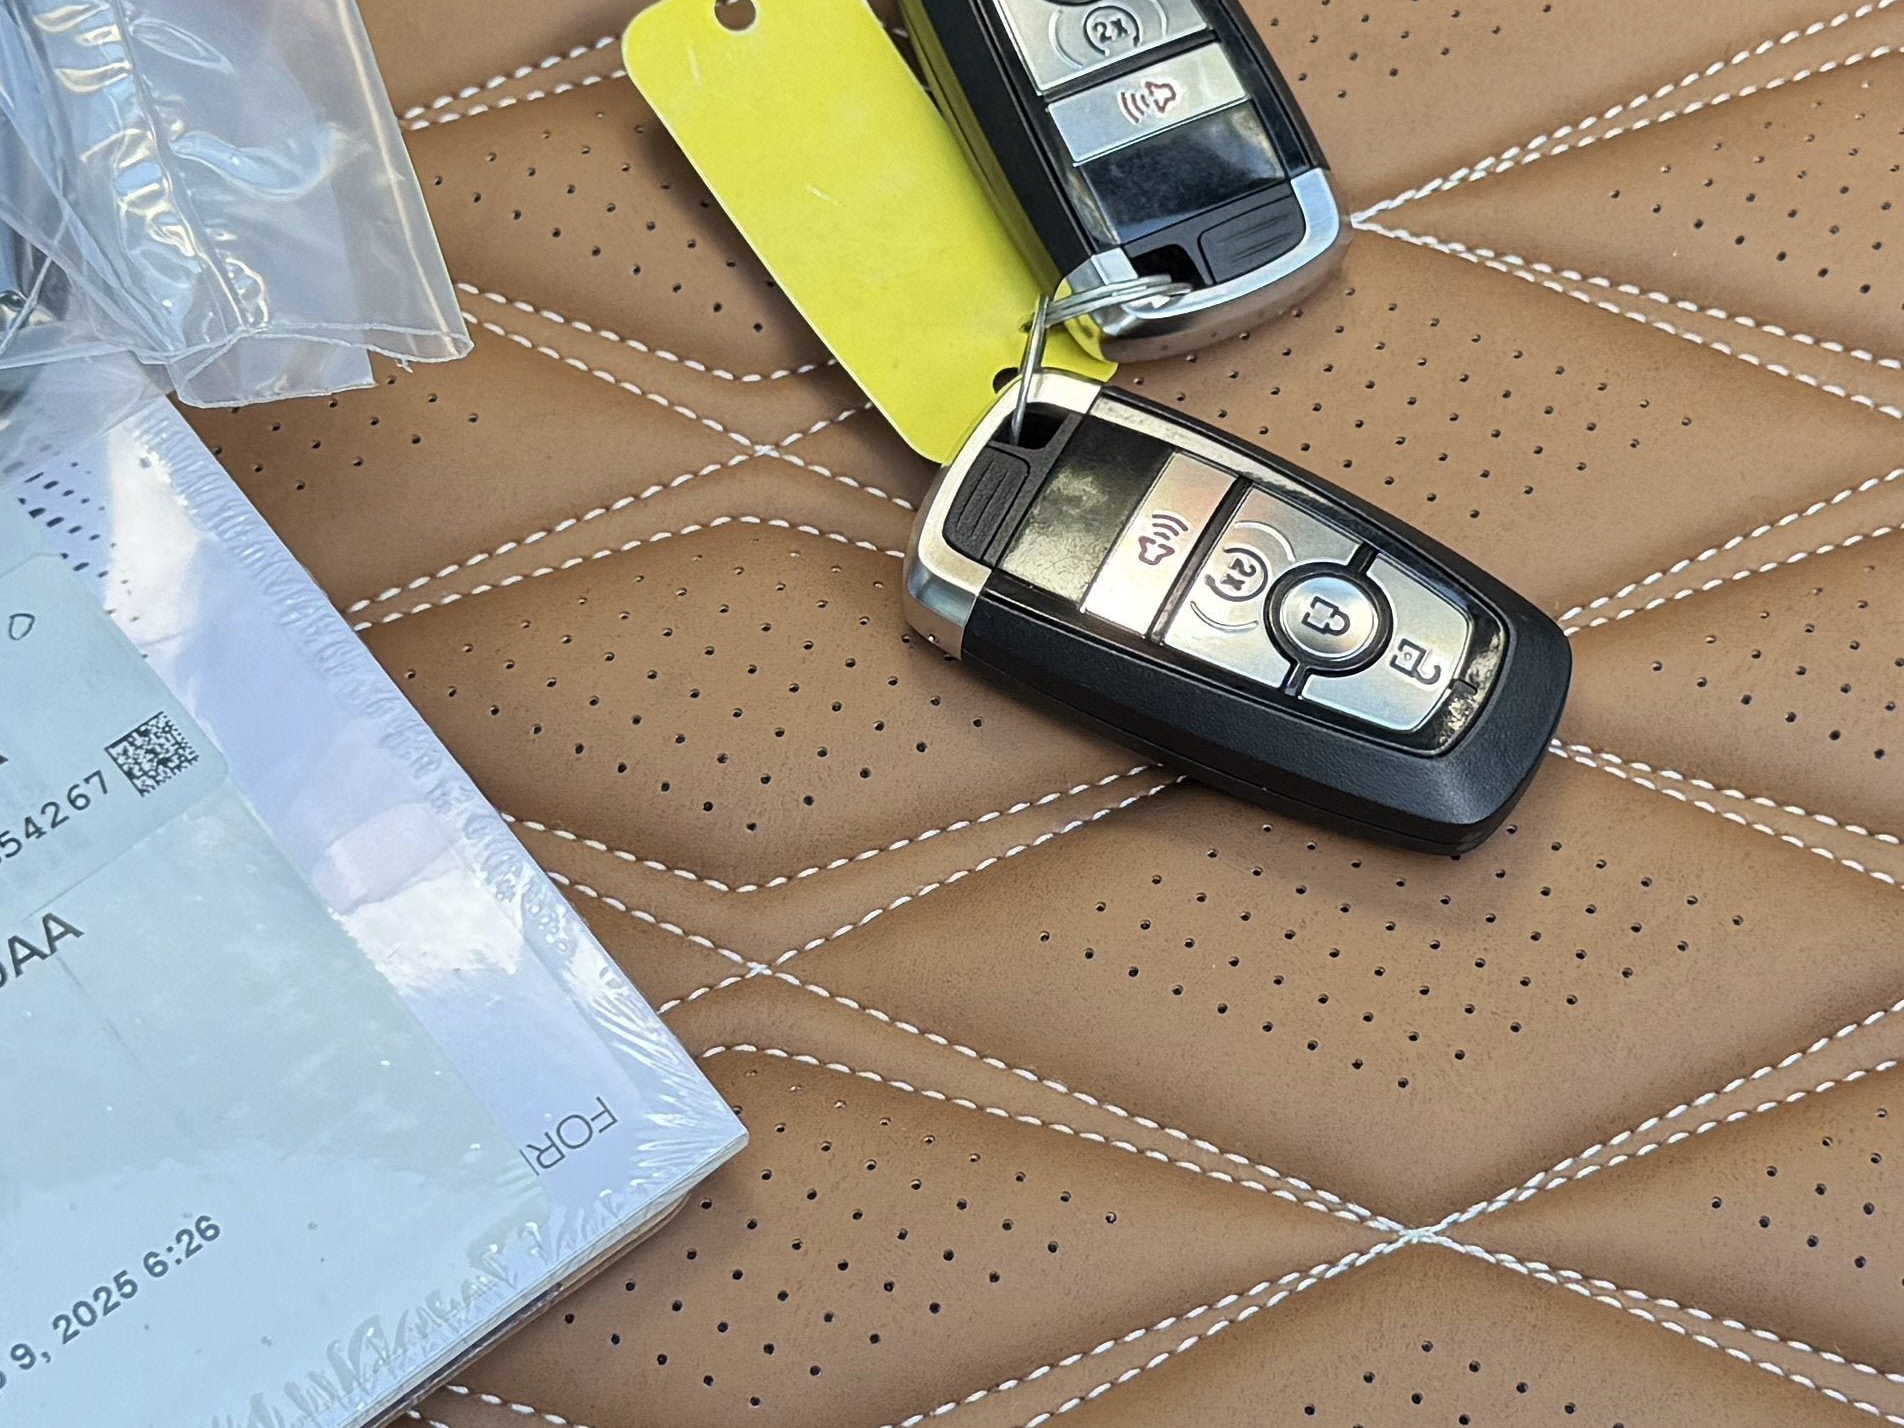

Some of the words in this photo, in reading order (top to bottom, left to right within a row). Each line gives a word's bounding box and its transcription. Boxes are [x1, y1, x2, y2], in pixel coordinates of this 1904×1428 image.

[518, 1095, 618, 1177] FOR
[9, 1342, 52, 1371] 9,
[51, 1269, 139, 1345] 2025
[142, 1214, 221, 1278] 6:26
